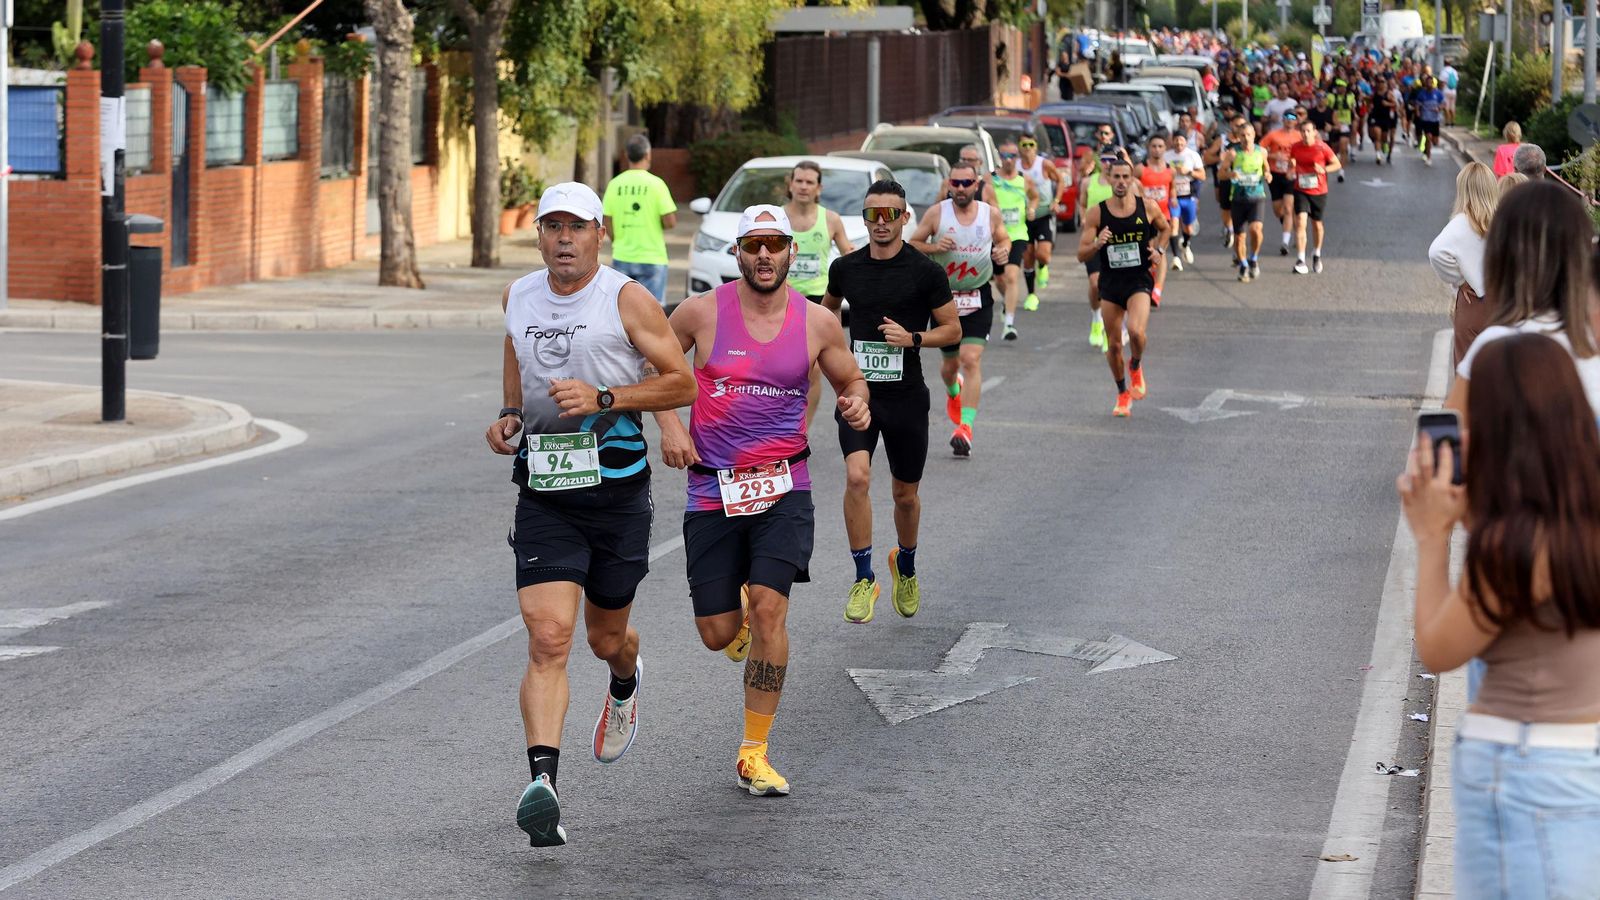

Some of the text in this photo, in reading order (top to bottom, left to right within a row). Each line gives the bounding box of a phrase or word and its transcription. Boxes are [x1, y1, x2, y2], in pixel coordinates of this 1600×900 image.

[864, 355, 890, 369] 100
[547, 452, 574, 473] 94
[738, 479, 776, 500] 293
